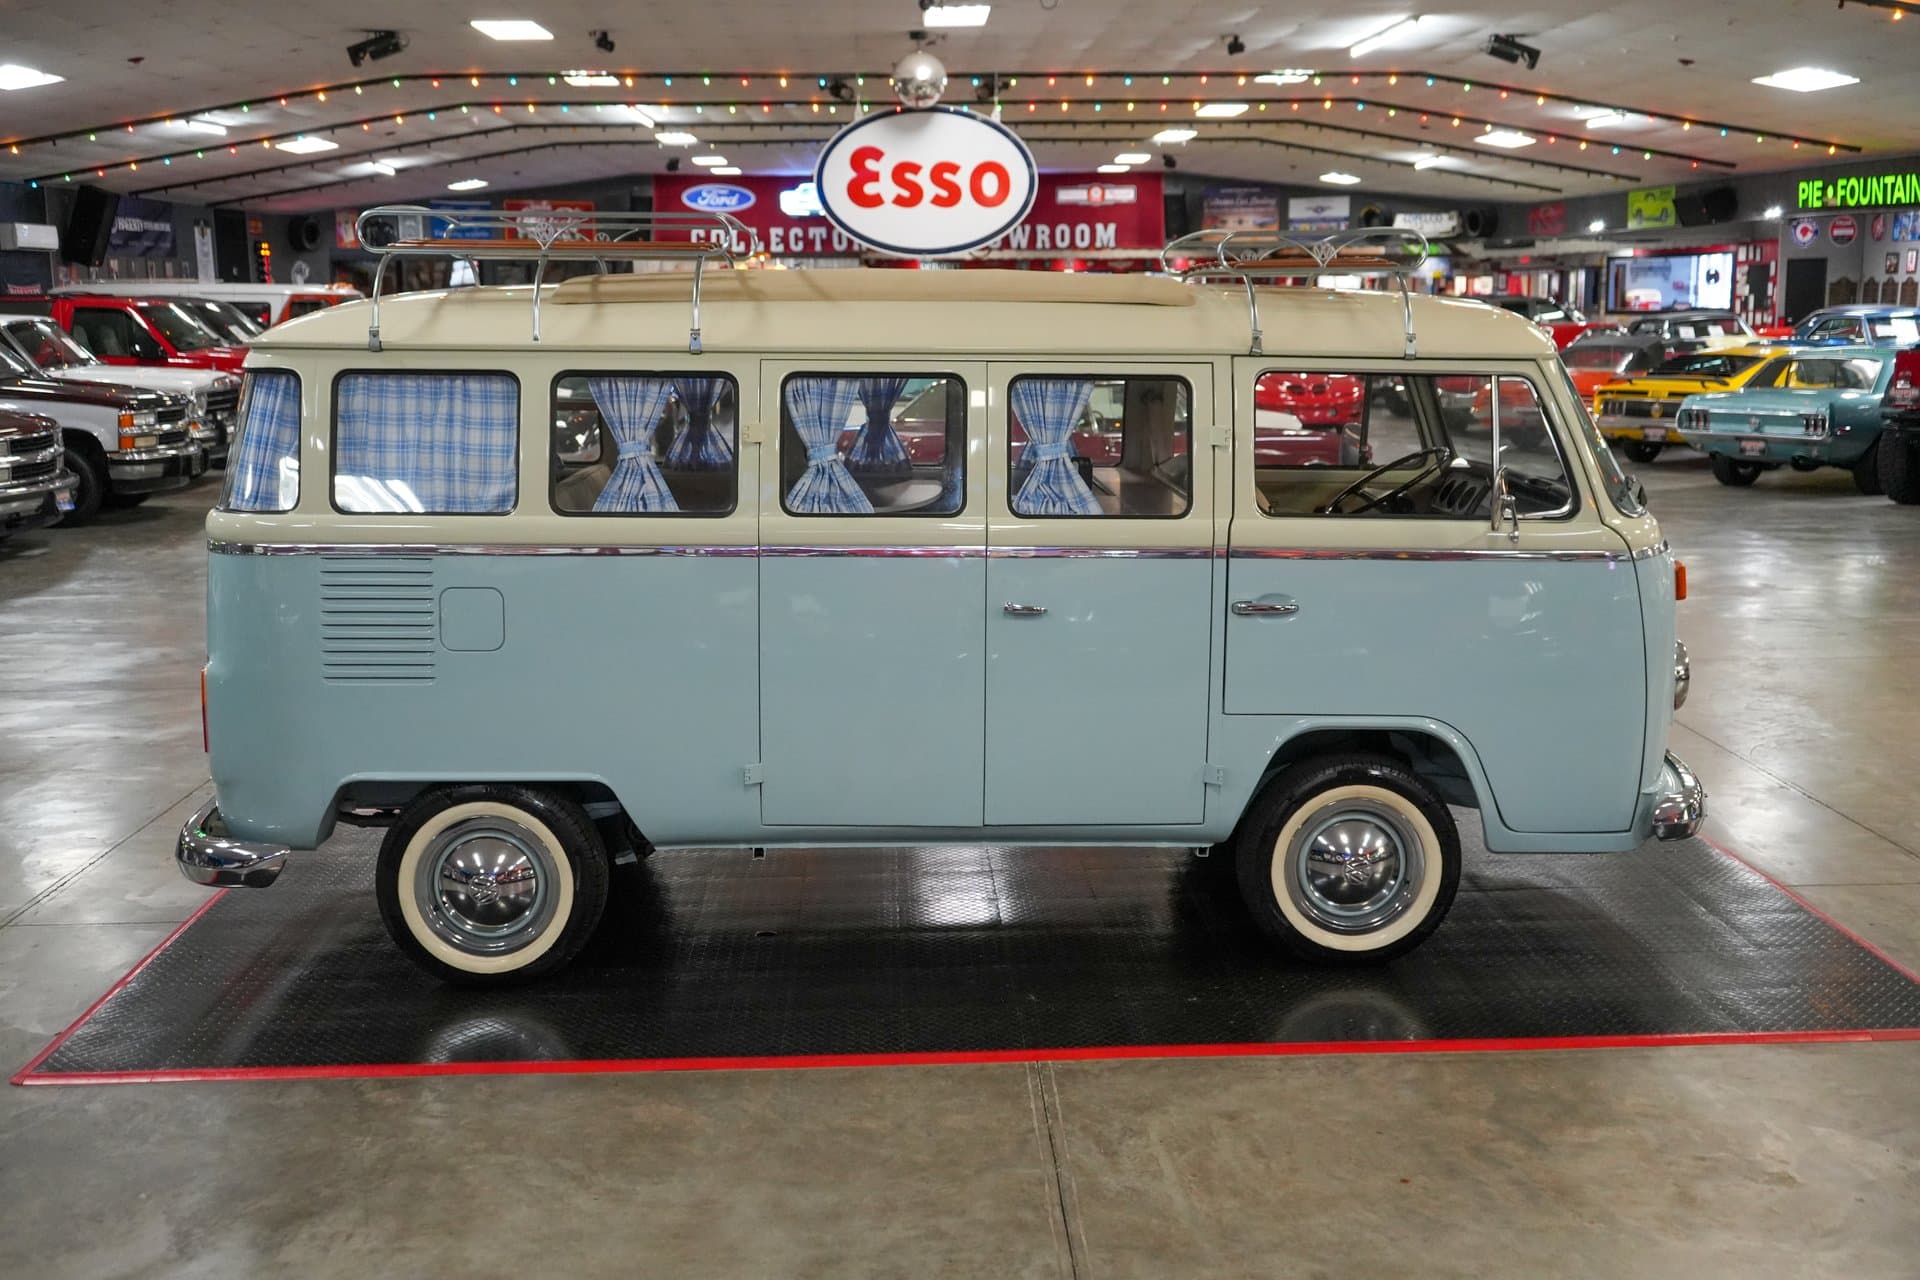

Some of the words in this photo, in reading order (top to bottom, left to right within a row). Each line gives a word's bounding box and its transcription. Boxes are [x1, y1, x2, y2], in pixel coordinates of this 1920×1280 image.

[697, 187, 740, 207] Ford
[1799, 180, 1823, 208] PIE
[1837, 173, 1920, 207] FOUNTAIN
